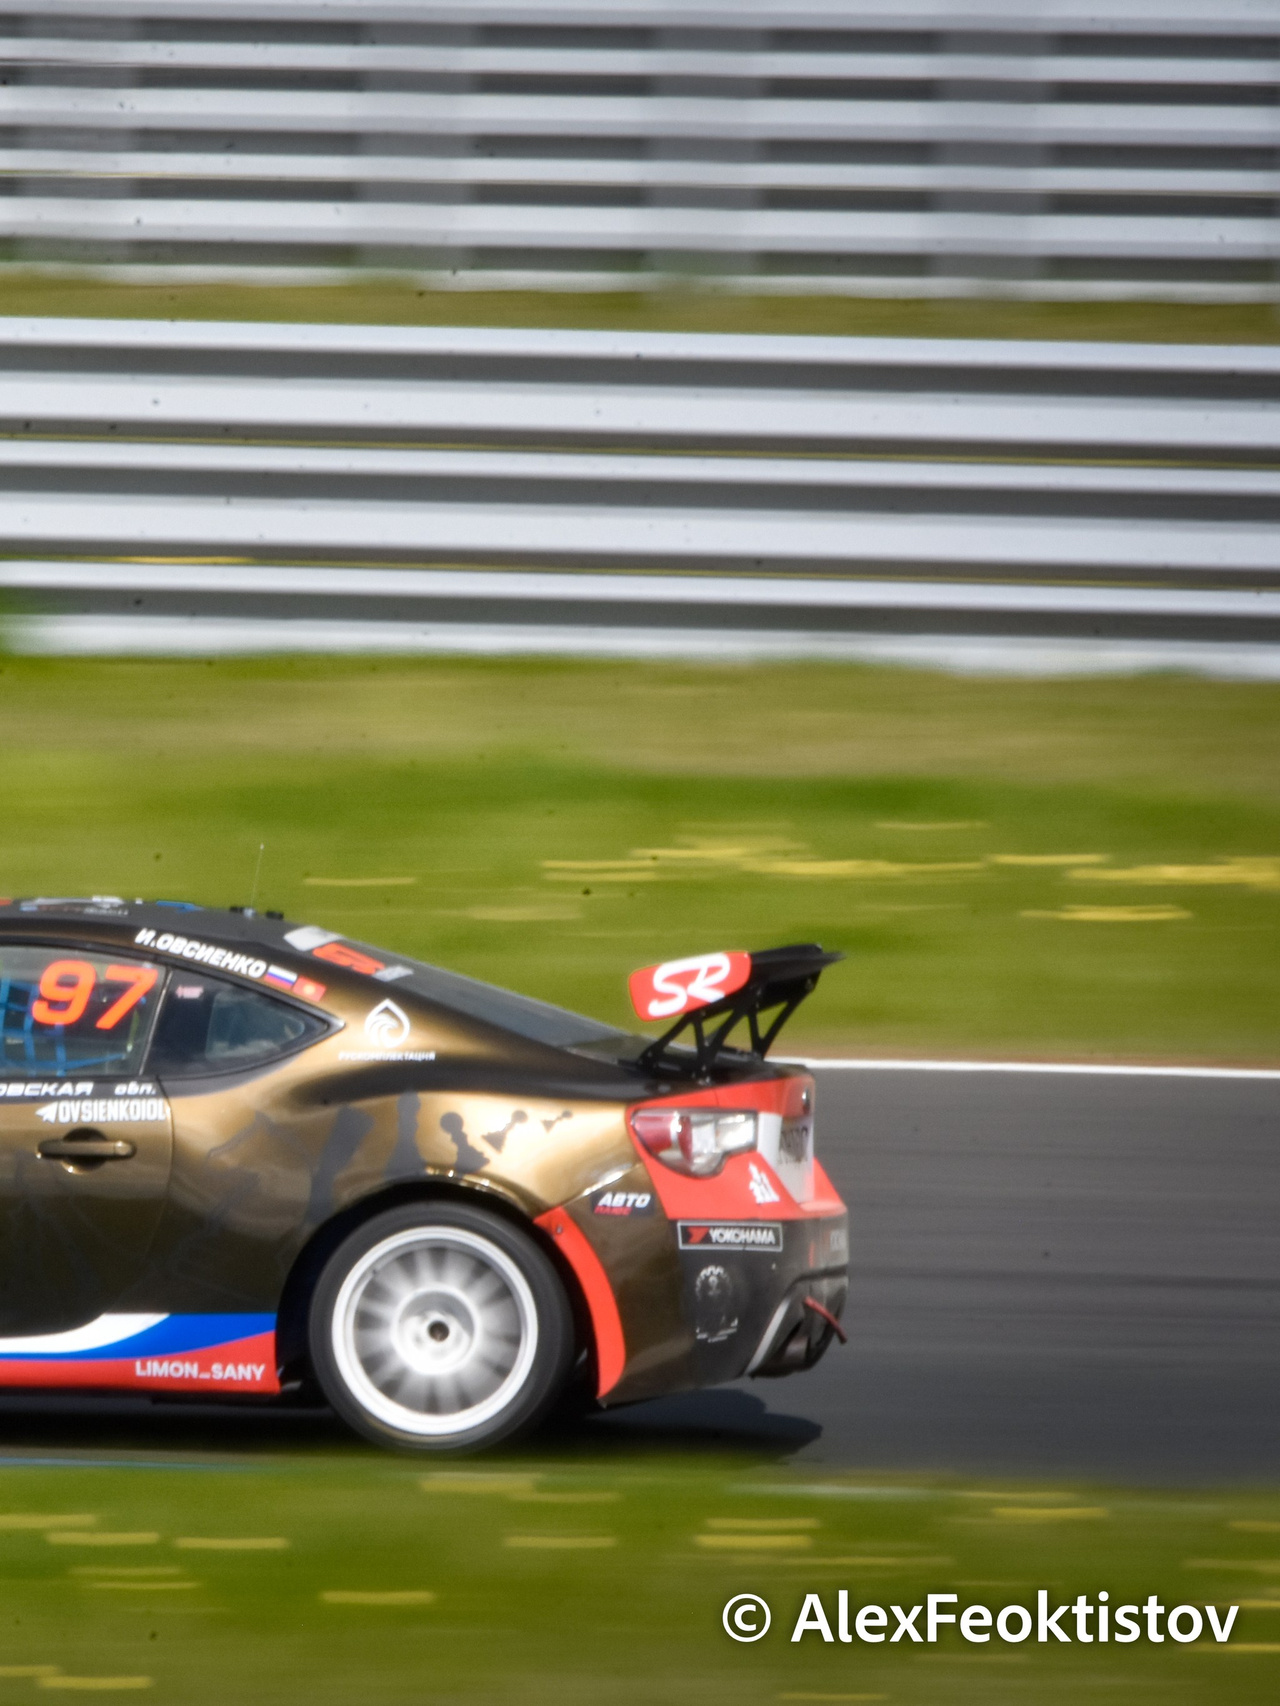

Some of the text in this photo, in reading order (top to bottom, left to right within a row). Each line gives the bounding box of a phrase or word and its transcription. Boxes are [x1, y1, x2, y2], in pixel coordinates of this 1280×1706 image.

[134, 927, 267, 978] И.ОВСИЕНКО
[31, 959, 159, 1031] 97
[648, 952, 731, 1017] SR
[709, 1226, 776, 1245] YOKOHAMA
